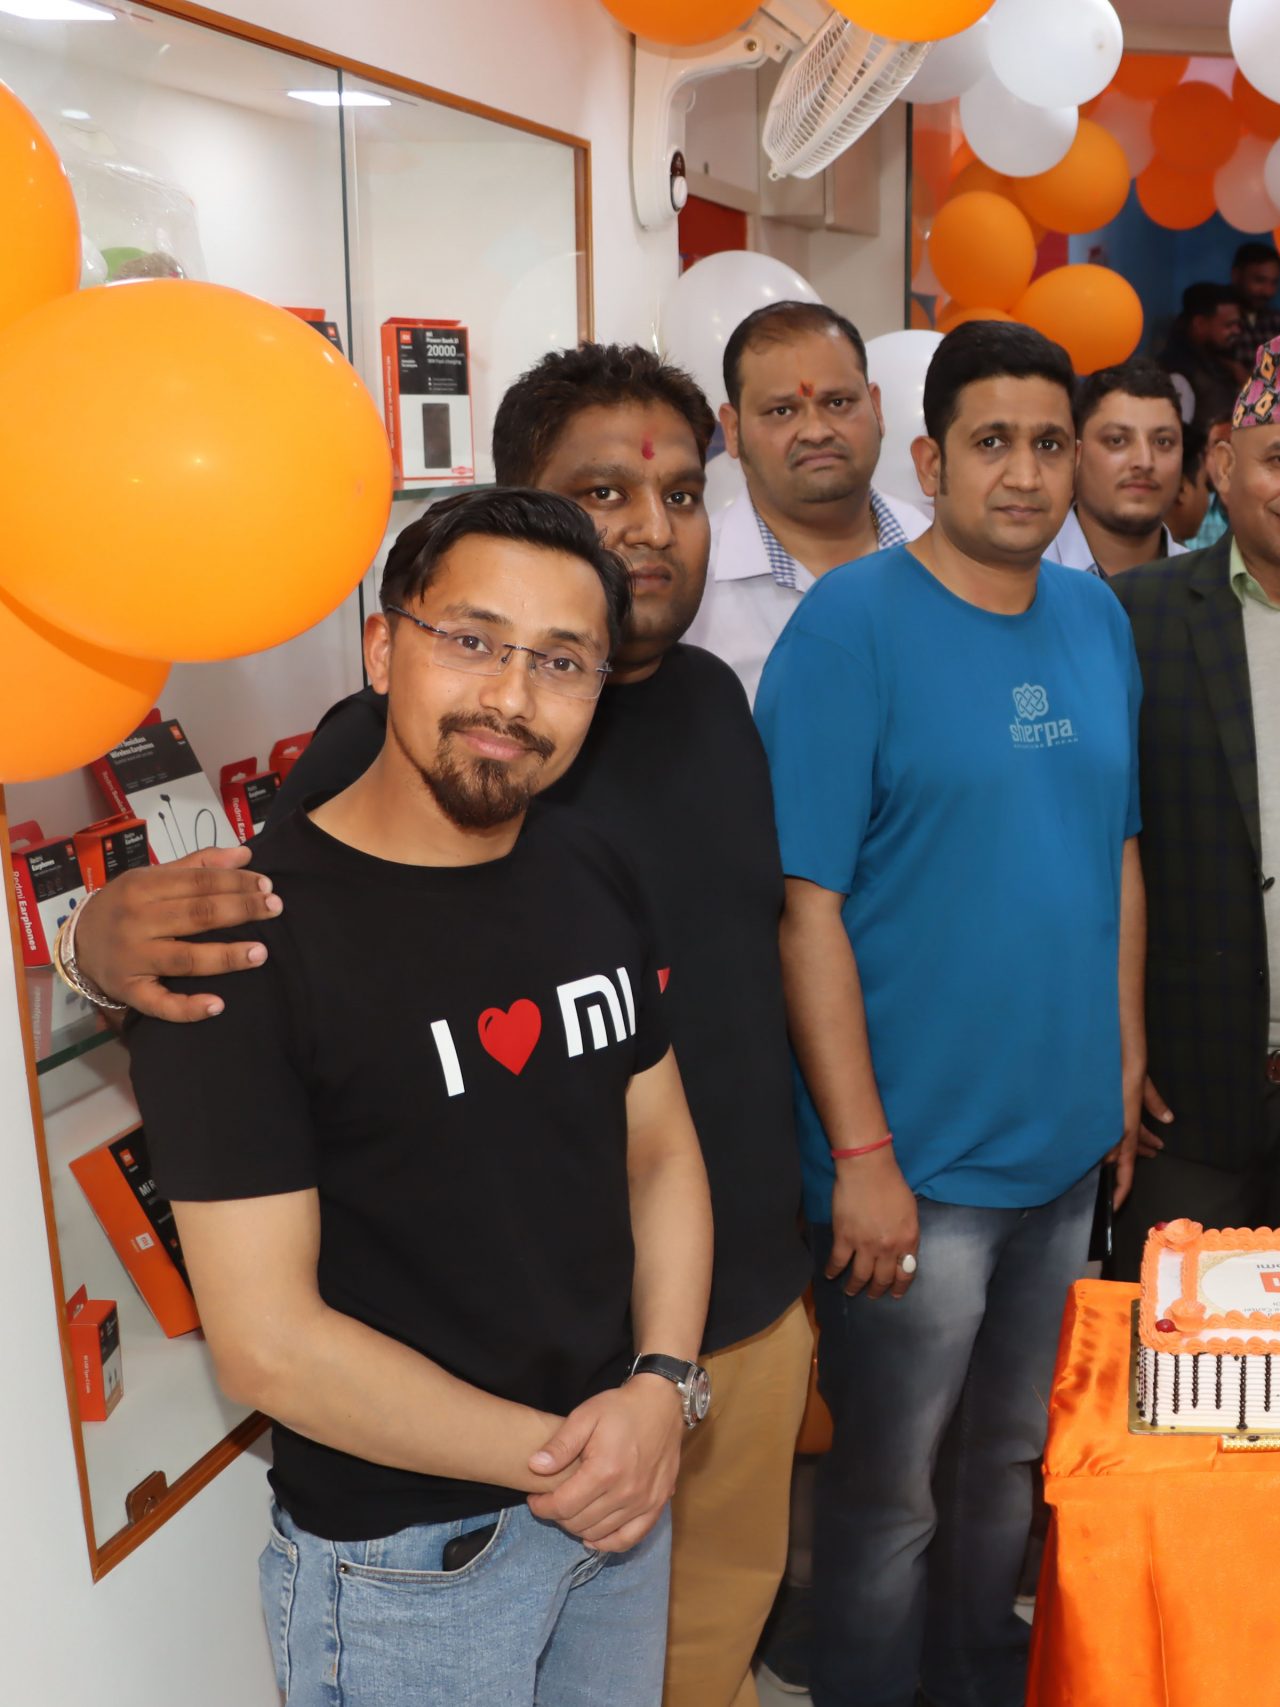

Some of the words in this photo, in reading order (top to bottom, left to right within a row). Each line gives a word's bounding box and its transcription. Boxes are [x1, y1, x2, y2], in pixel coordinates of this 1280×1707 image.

[427, 345, 456, 357] 20000
[1010, 716, 1073, 748] sherpa
[232, 797, 244, 822] Redmi
[237, 822, 247, 844] Earp
[12, 870, 25, 898] Redmi
[18, 898, 37, 951] Earphones
[430, 1019, 465, 1097] I
